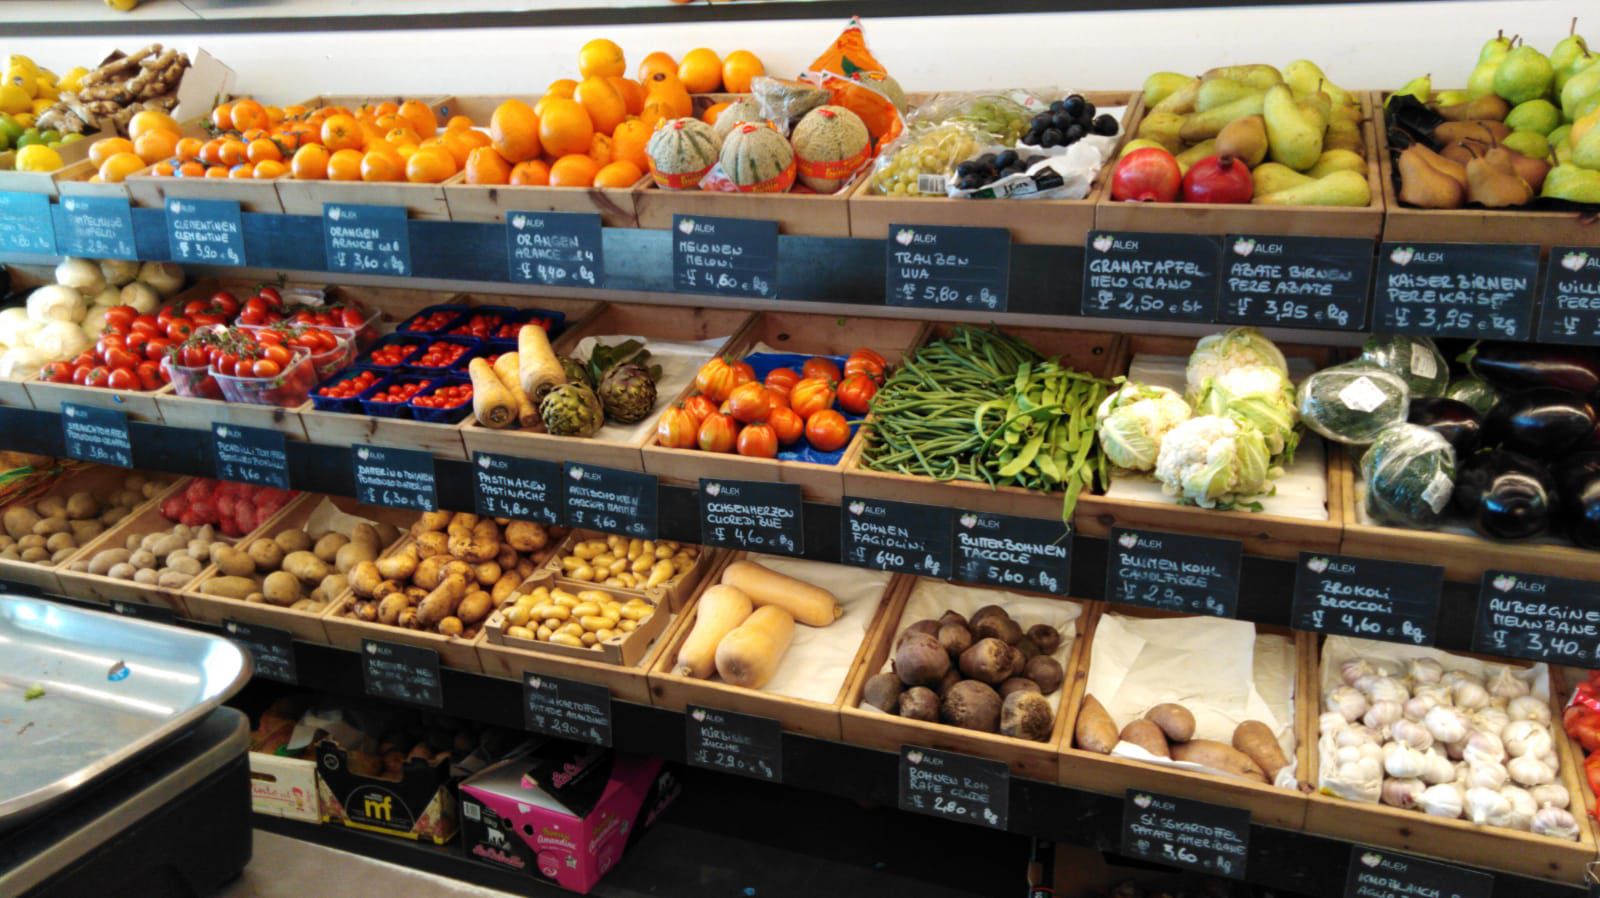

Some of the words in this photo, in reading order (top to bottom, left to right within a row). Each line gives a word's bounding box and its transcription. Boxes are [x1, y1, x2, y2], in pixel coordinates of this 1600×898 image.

[340, 210, 357, 220] ALEX
[526, 219, 545, 229] ALEX
[694, 224, 715, 233] ALEX
[329, 226, 379, 239] ORANGEN
[913, 233, 937, 244] ALEX
[332, 239, 374, 251] ARANCE
[517, 233, 579, 248] ORANGEN
[1112, 240, 1139, 250] ALEX
[515, 248, 561, 261] ARANCE
[680, 241, 743, 256] MELONEN
[1254, 244, 1283, 254] ALEX
[354, 252, 378, 269] 3,60
[1413, 251, 1444, 262] ALEX
[1231, 263, 1282, 278] ABATE
[705, 272, 737, 289] 4,60
[1090, 276, 1128, 289] MELO
[1131, 276, 1192, 290] GRANO
[1229, 278, 1275, 293] PERE
[1274, 280, 1334, 296] ABATE
[923, 286, 959, 303] 5,80
[1119, 292, 1164, 312] 2,50
[1264, 299, 1308, 321] 3,95
[1419, 308, 1473, 332] 3,95
[490, 460, 509, 469] ALEX
[583, 471, 602, 481] ALEX
[719, 486, 740, 495] ALEX
[383, 490, 409, 506] 6,30
[707, 502, 794, 518] OCHSENHERZEN
[864, 506, 886, 515] ALEX
[850, 519, 909, 538] BOHNEN
[976, 519, 1000, 529] ALEX
[735, 528, 764, 546] 4,60
[1136, 538, 1162, 549] ALEX
[960, 545, 1031, 565] TACCOLE
[1327, 562, 1356, 574] ALEX
[987, 567, 1025, 584] 5,60
[1515, 581, 1546, 592] ALEX
[1341, 614, 1381, 633] 4,60
[1493, 612, 1600, 637] MELANZANE
[1527, 632, 1580, 657] 3,40
[705, 714, 724, 723] ALEX
[922, 756, 944, 767] ALEX
[364, 796, 392, 822] mf
[934, 796, 967, 814] 2,80
[1151, 799, 1176, 811] ALEX
[1162, 843, 1199, 863] 3,60
[1380, 859, 1408, 872] ALEX
